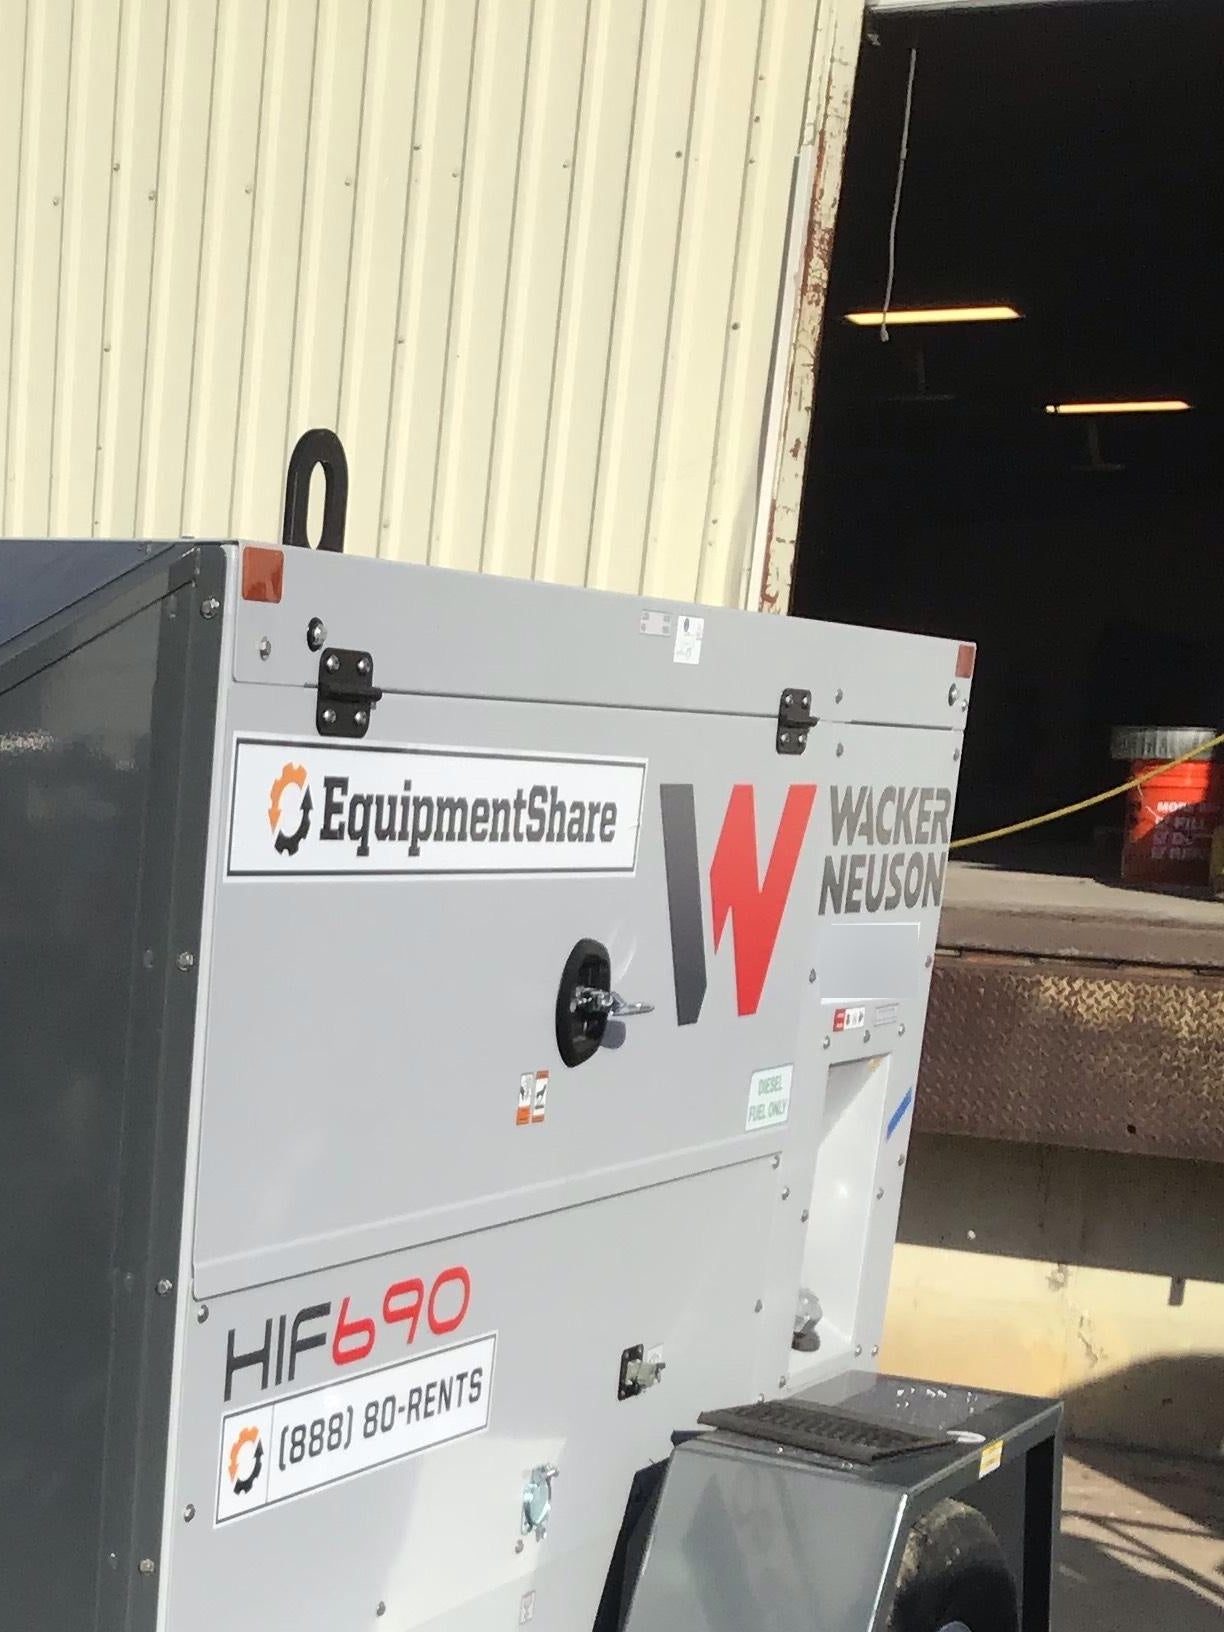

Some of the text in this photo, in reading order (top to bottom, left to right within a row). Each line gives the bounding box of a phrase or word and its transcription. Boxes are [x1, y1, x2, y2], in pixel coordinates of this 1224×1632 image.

[319, 775, 618, 857] EquipmentShare
[830, 785, 952, 846] WACKER
[818, 851, 947, 916] NEUSON
[748, 1099, 789, 1122] FUEL ONLY
[758, 1075, 783, 1096] DIESEL
[224, 1266, 471, 1403] HIF690
[278, 1366, 483, 1472] (888) 80-RENTS
